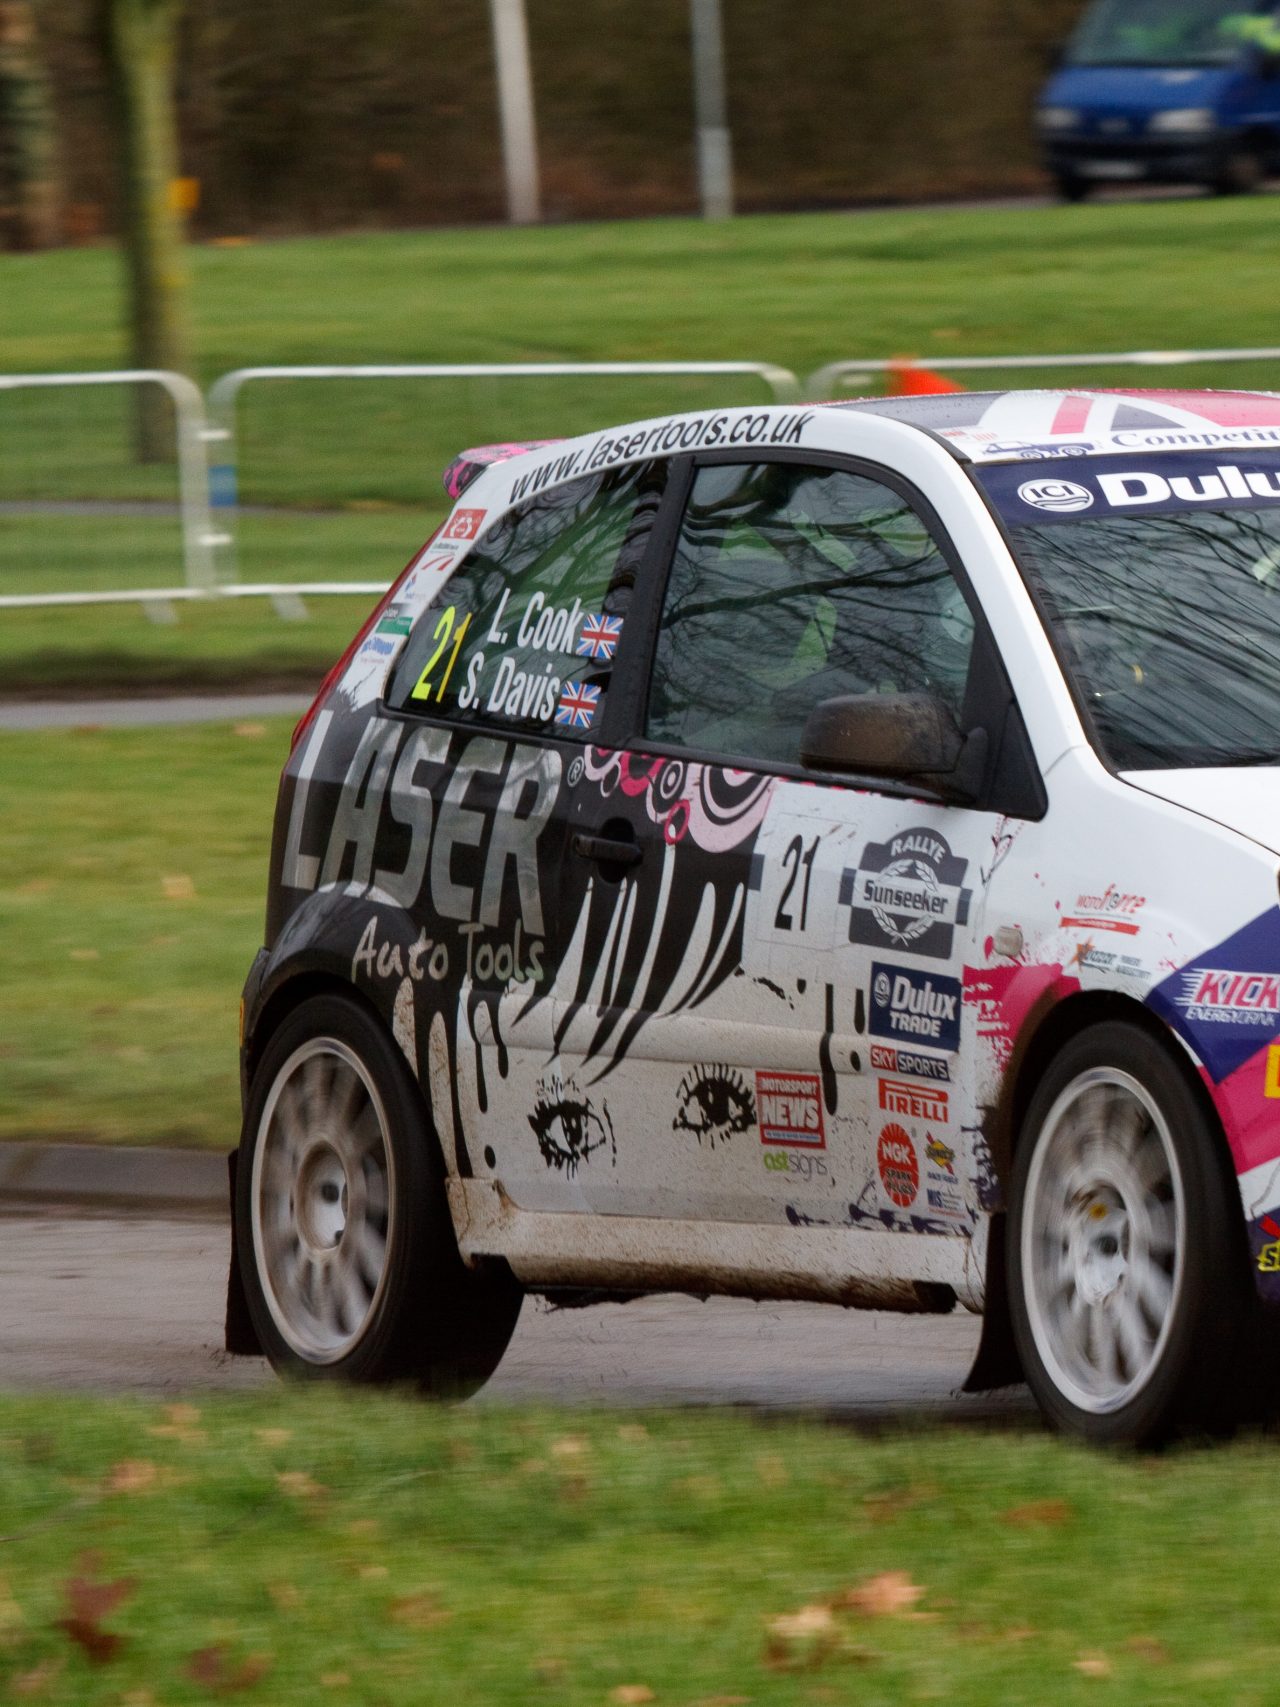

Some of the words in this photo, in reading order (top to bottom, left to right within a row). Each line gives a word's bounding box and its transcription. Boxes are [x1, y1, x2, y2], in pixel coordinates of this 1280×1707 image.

[509, 410, 816, 505] www.lasertools.co.uk
[1030, 485, 1075, 499] ICI
[486, 587, 512, 645] L.
[517, 590, 584, 654] Cook
[411, 605, 473, 703] 21
[458, 651, 485, 710] S.
[487, 656, 561, 722] Davis
[281, 709, 563, 937] LASER
[890, 834, 946, 864] RALLYE
[774, 832, 820, 931] 21
[863, 879, 949, 915] Sunseeker
[351, 914, 449, 984] Auto
[457, 918, 545, 983] Tools
[890, 974, 958, 1022] Dulux
[889, 1009, 942, 1038] TRADE
[871, 1048, 896, 1069] SKY
[898, 1053, 949, 1079] SPORTS
[760, 1076, 818, 1096] MOTORSPORT
[878, 1077, 949, 1124] PIRELLI
[760, 1094, 820, 1130] NEWS
[881, 1140, 913, 1166] NGK
[884, 1166, 913, 1181] SPARK
